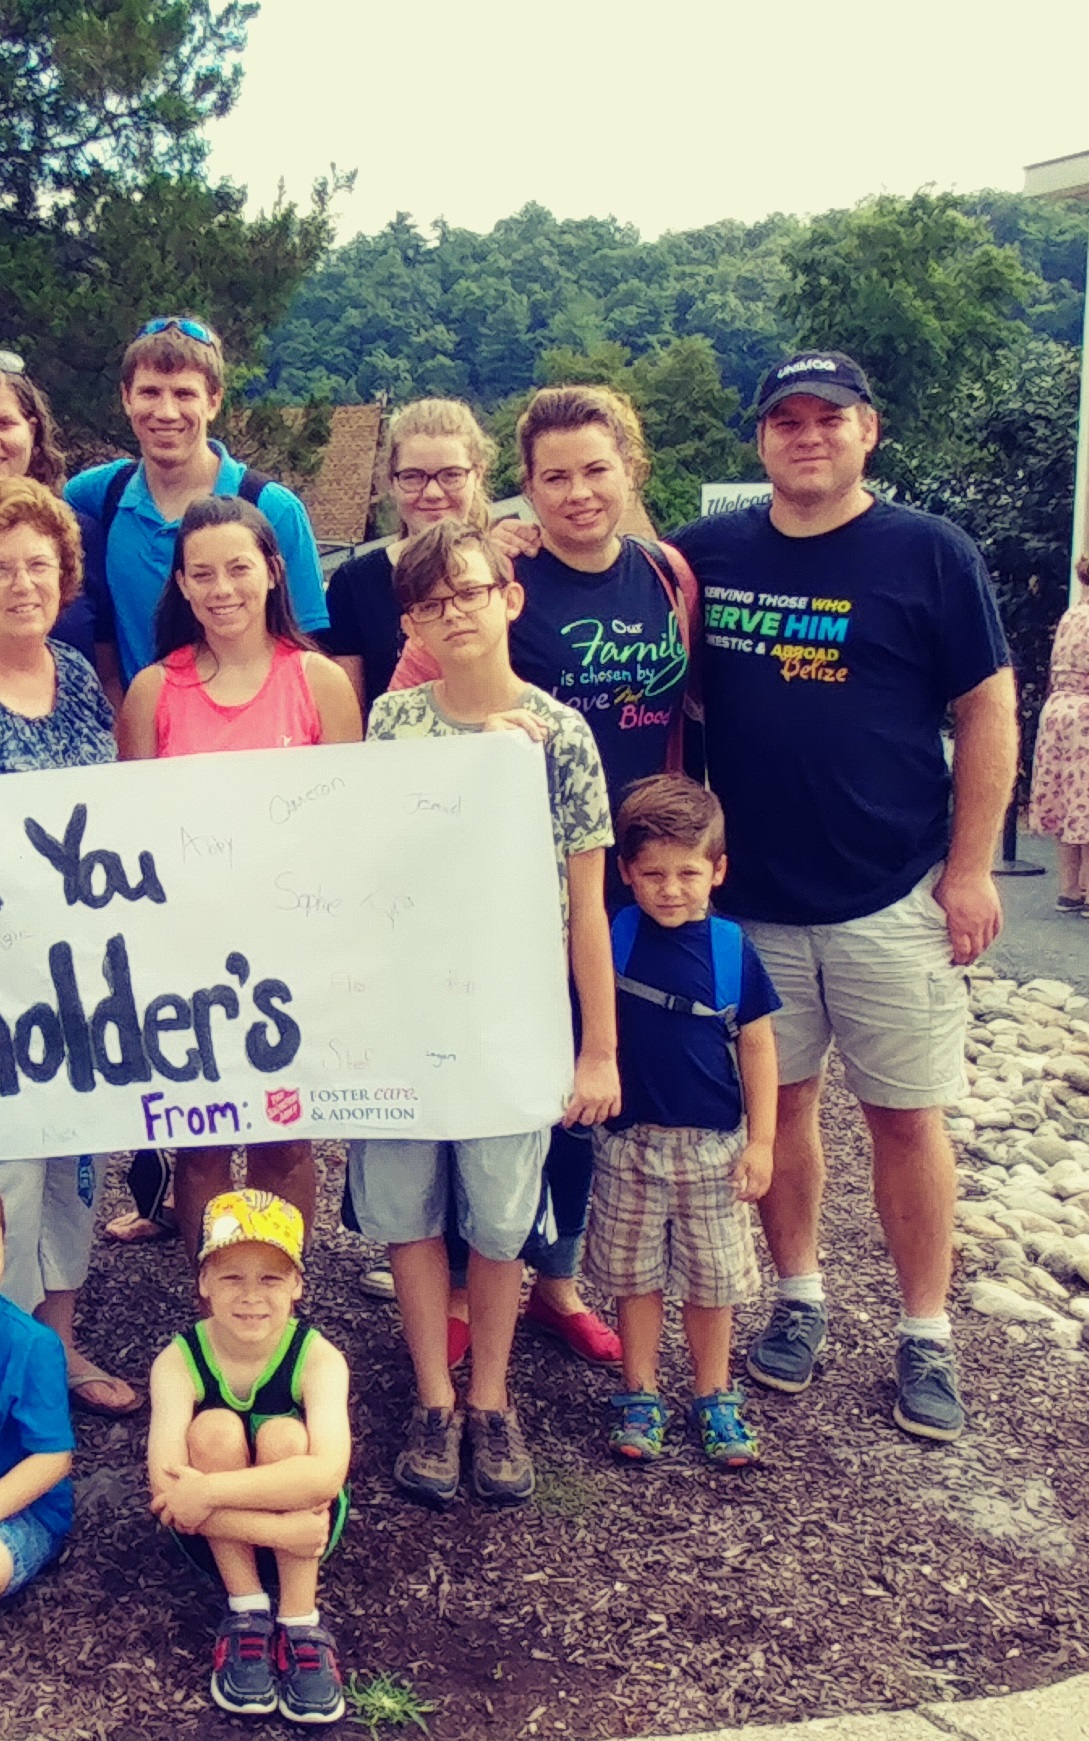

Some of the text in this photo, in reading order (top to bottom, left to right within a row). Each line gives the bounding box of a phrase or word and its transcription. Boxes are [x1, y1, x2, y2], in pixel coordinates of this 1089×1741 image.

[708, 493, 772, 515] Welcom
[758, 593, 809, 610] THOSE
[812, 598, 851, 613] WHO
[784, 614, 849, 643] HIM
[561, 611, 688, 696] Family
[706, 633, 840, 661] MESTIC & ABROAD
[561, 664, 655, 686] is chosen by
[780, 655, 848, 683] Belize
[619, 704, 671, 729] Blood
[24, 803, 167, 910] You
[310, 1089, 369, 1103] FOSTER
[141, 1092, 252, 1141] From:
[311, 1107, 415, 1121] & ADOPTION
